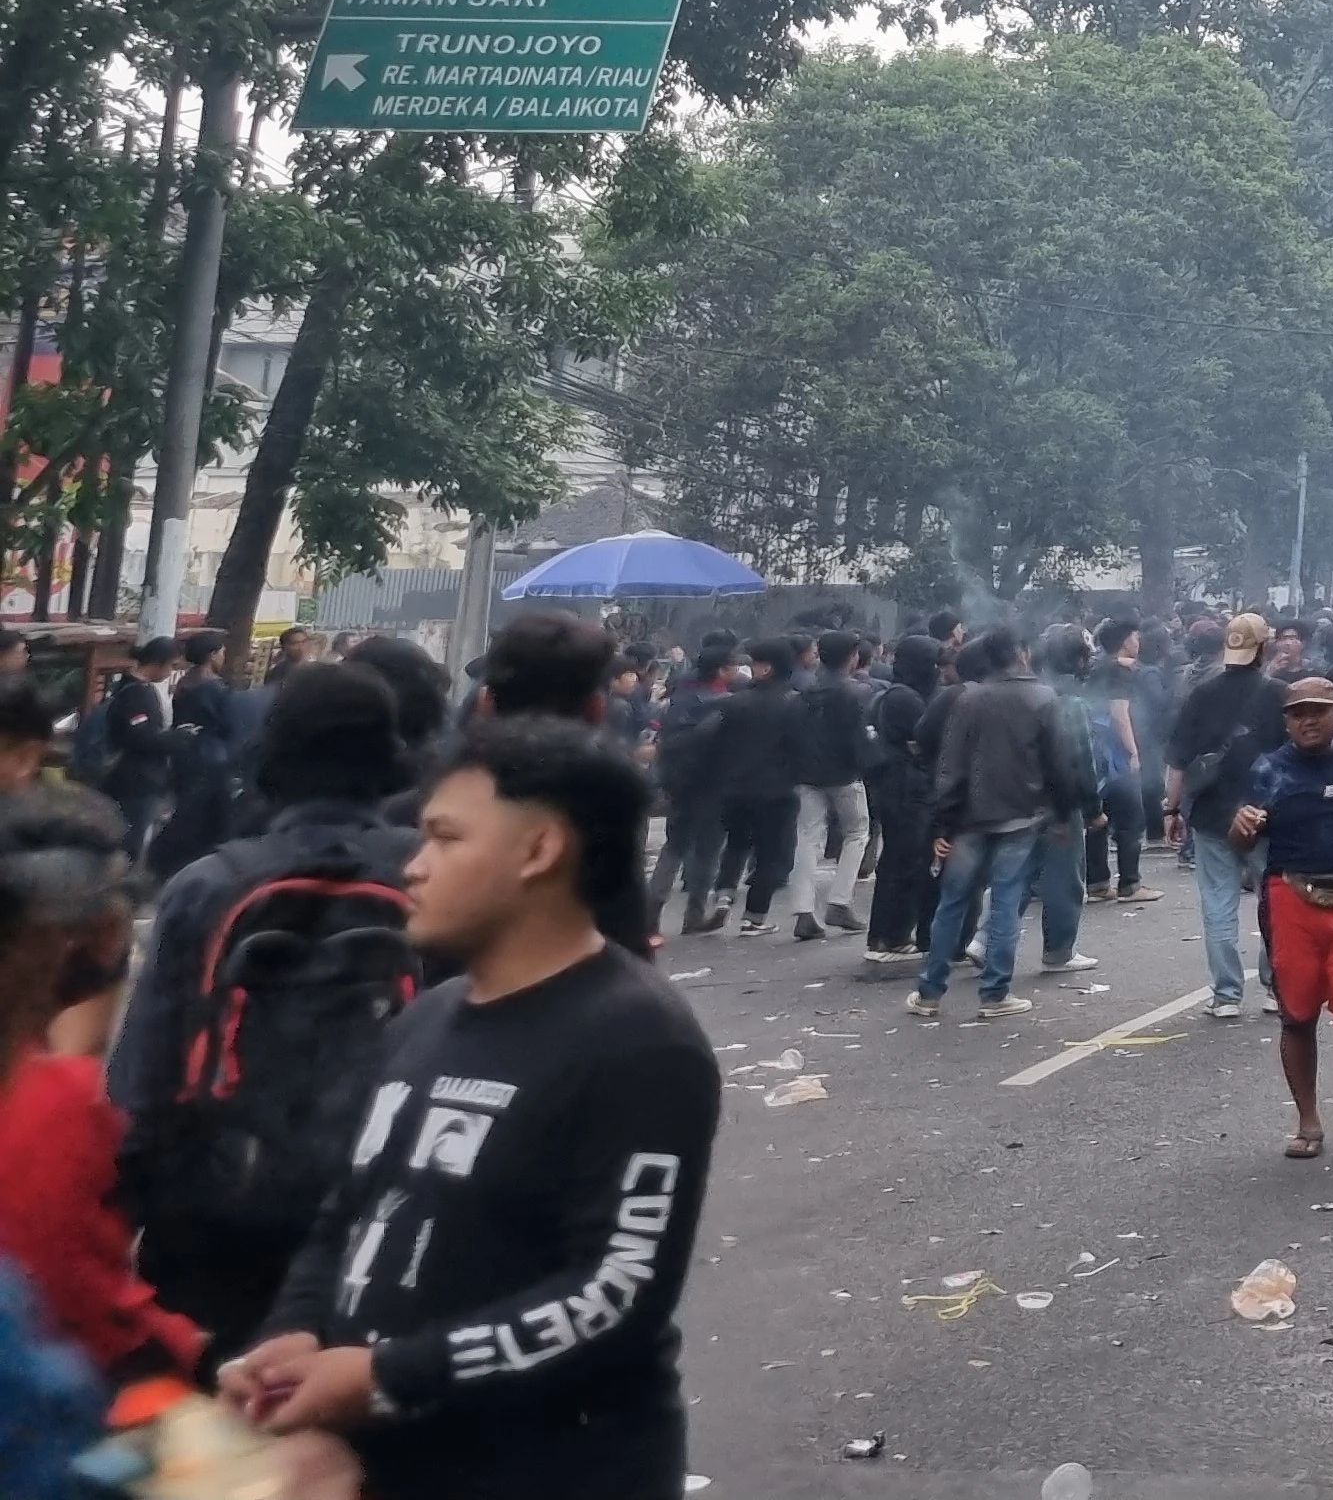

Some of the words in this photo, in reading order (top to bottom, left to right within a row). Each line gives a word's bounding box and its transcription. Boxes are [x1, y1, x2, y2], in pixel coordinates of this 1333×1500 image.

[398, 33, 602, 56] TRUNOJOYO
[382, 65, 418, 86] RE.
[425, 66, 653, 88] MARTADINATA/RIAU
[448, 1152, 681, 1380] CONCRETE
